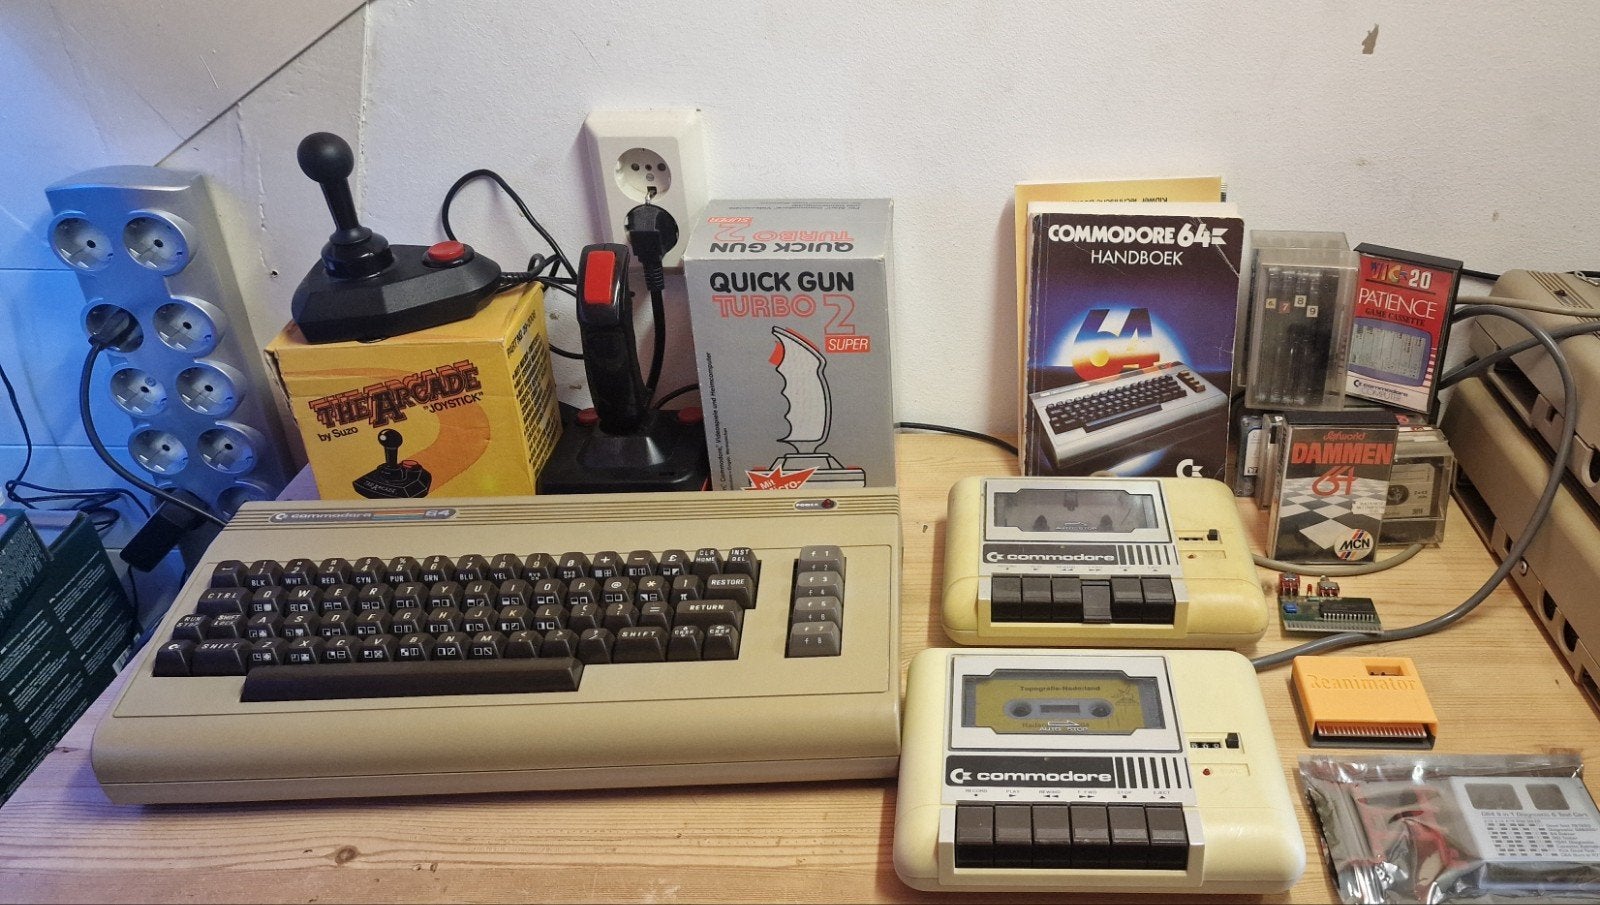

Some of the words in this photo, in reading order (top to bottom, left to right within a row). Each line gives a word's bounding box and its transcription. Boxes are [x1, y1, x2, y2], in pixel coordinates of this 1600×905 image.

[753, 231, 854, 242] TURBO
[1049, 225, 1175, 244] COMMODORE
[1177, 223, 1211, 247] 64
[710, 243, 766, 253] GUN
[773, 243, 854, 253] QUICK
[1091, 250, 1183, 265] HANDBOEK
[709, 272, 791, 293] QUICK
[797, 272, 854, 292] GUN
[1358, 288, 1438, 319] PATIENCE
[712, 294, 816, 318] TURBO
[823, 294, 855, 335] 2
[1365, 308, 1387, 319] GAME
[1387, 312, 1426, 326] CASSETTE
[828, 338, 868, 351] SUPER
[706, 352, 715, 397] Heimcomputer
[309, 388, 370, 429] THE
[363, 359, 482, 429] ARCADE
[1363, 382, 1409, 397] commodore
[423, 391, 484, 413] "JOYSTICK"
[317, 432, 331, 442] by
[332, 426, 358, 439] Suzo
[1291, 442, 1393, 465] DAMMEN
[760, 479, 776, 489] Mit
[1312, 466, 1356, 497] 64
[291, 512, 372, 520] commodore
[425, 509, 450, 517] 64
[1340, 539, 1370, 550] MCN
[1007, 552, 1115, 562] commodore
[252, 579, 265, 587] BLK
[356, 576, 371, 584] CYN
[1307, 674, 1416, 690] Reanimator
[977, 770, 1112, 783] commodore
